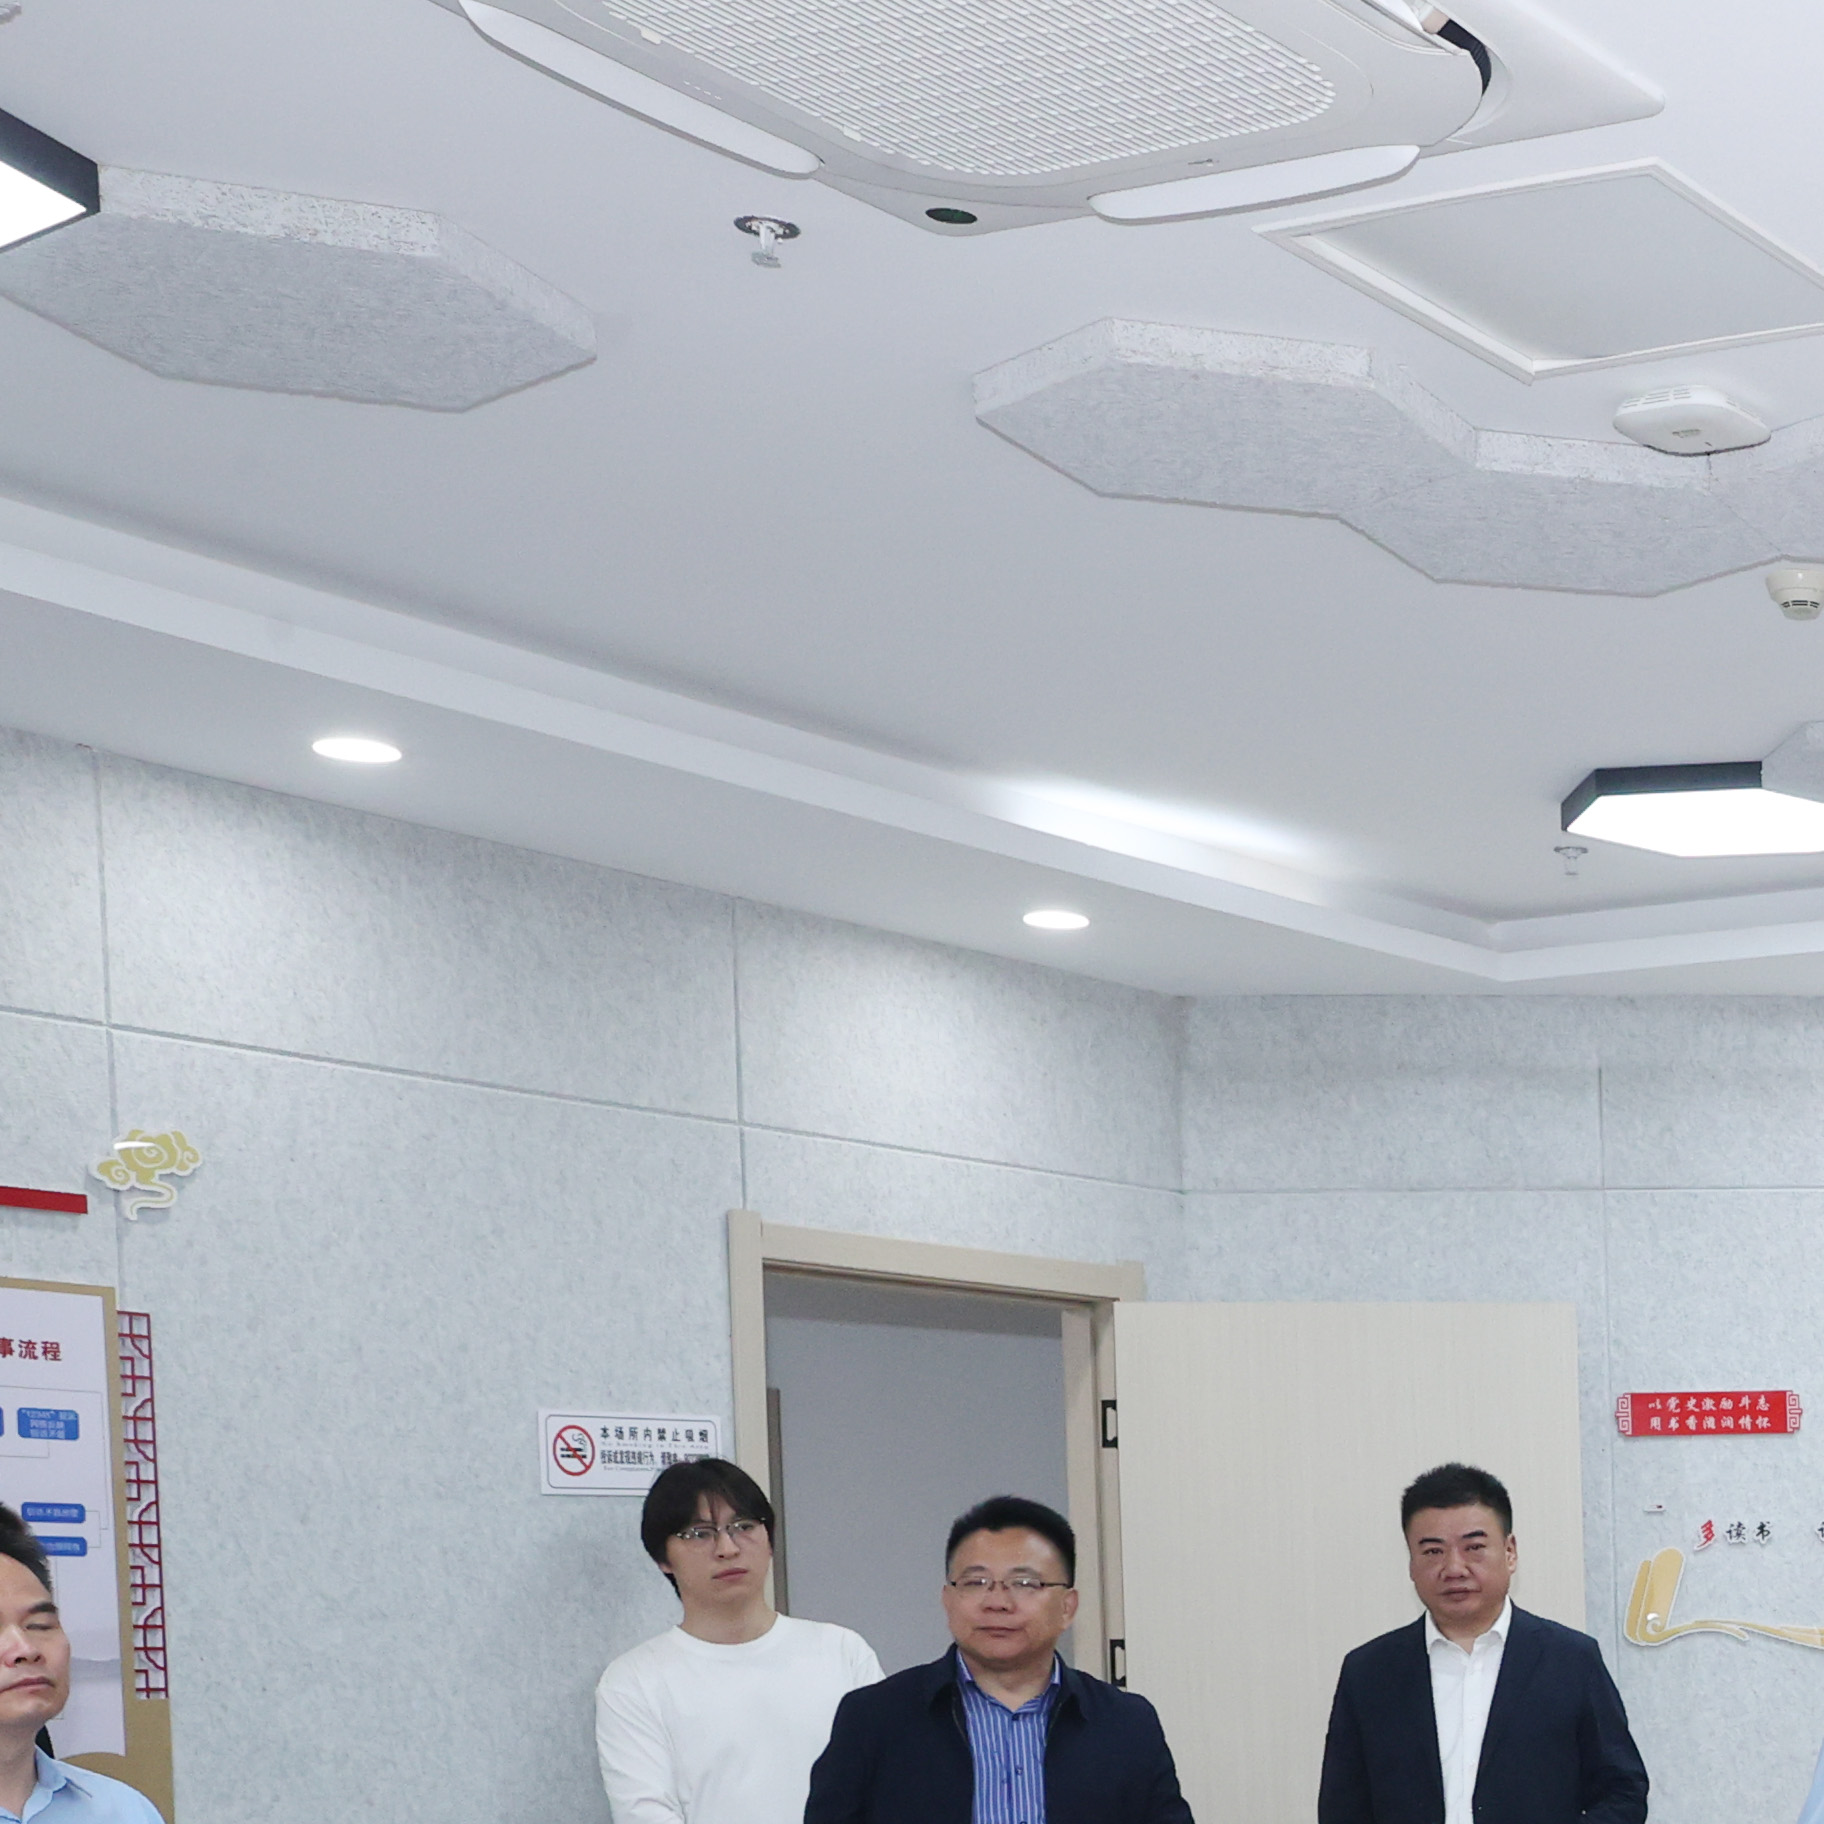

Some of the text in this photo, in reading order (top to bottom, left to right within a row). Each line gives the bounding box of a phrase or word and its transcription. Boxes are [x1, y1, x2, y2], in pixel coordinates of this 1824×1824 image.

[1648, 1395, 1771, 1413] 以党史激励斗志
[1649, 1415, 1771, 1431] 用书香滋润情怀
[600, 1426, 709, 1443] 本场所内禁止吸烟
[1695, 1519, 1773, 1550] 多读书
